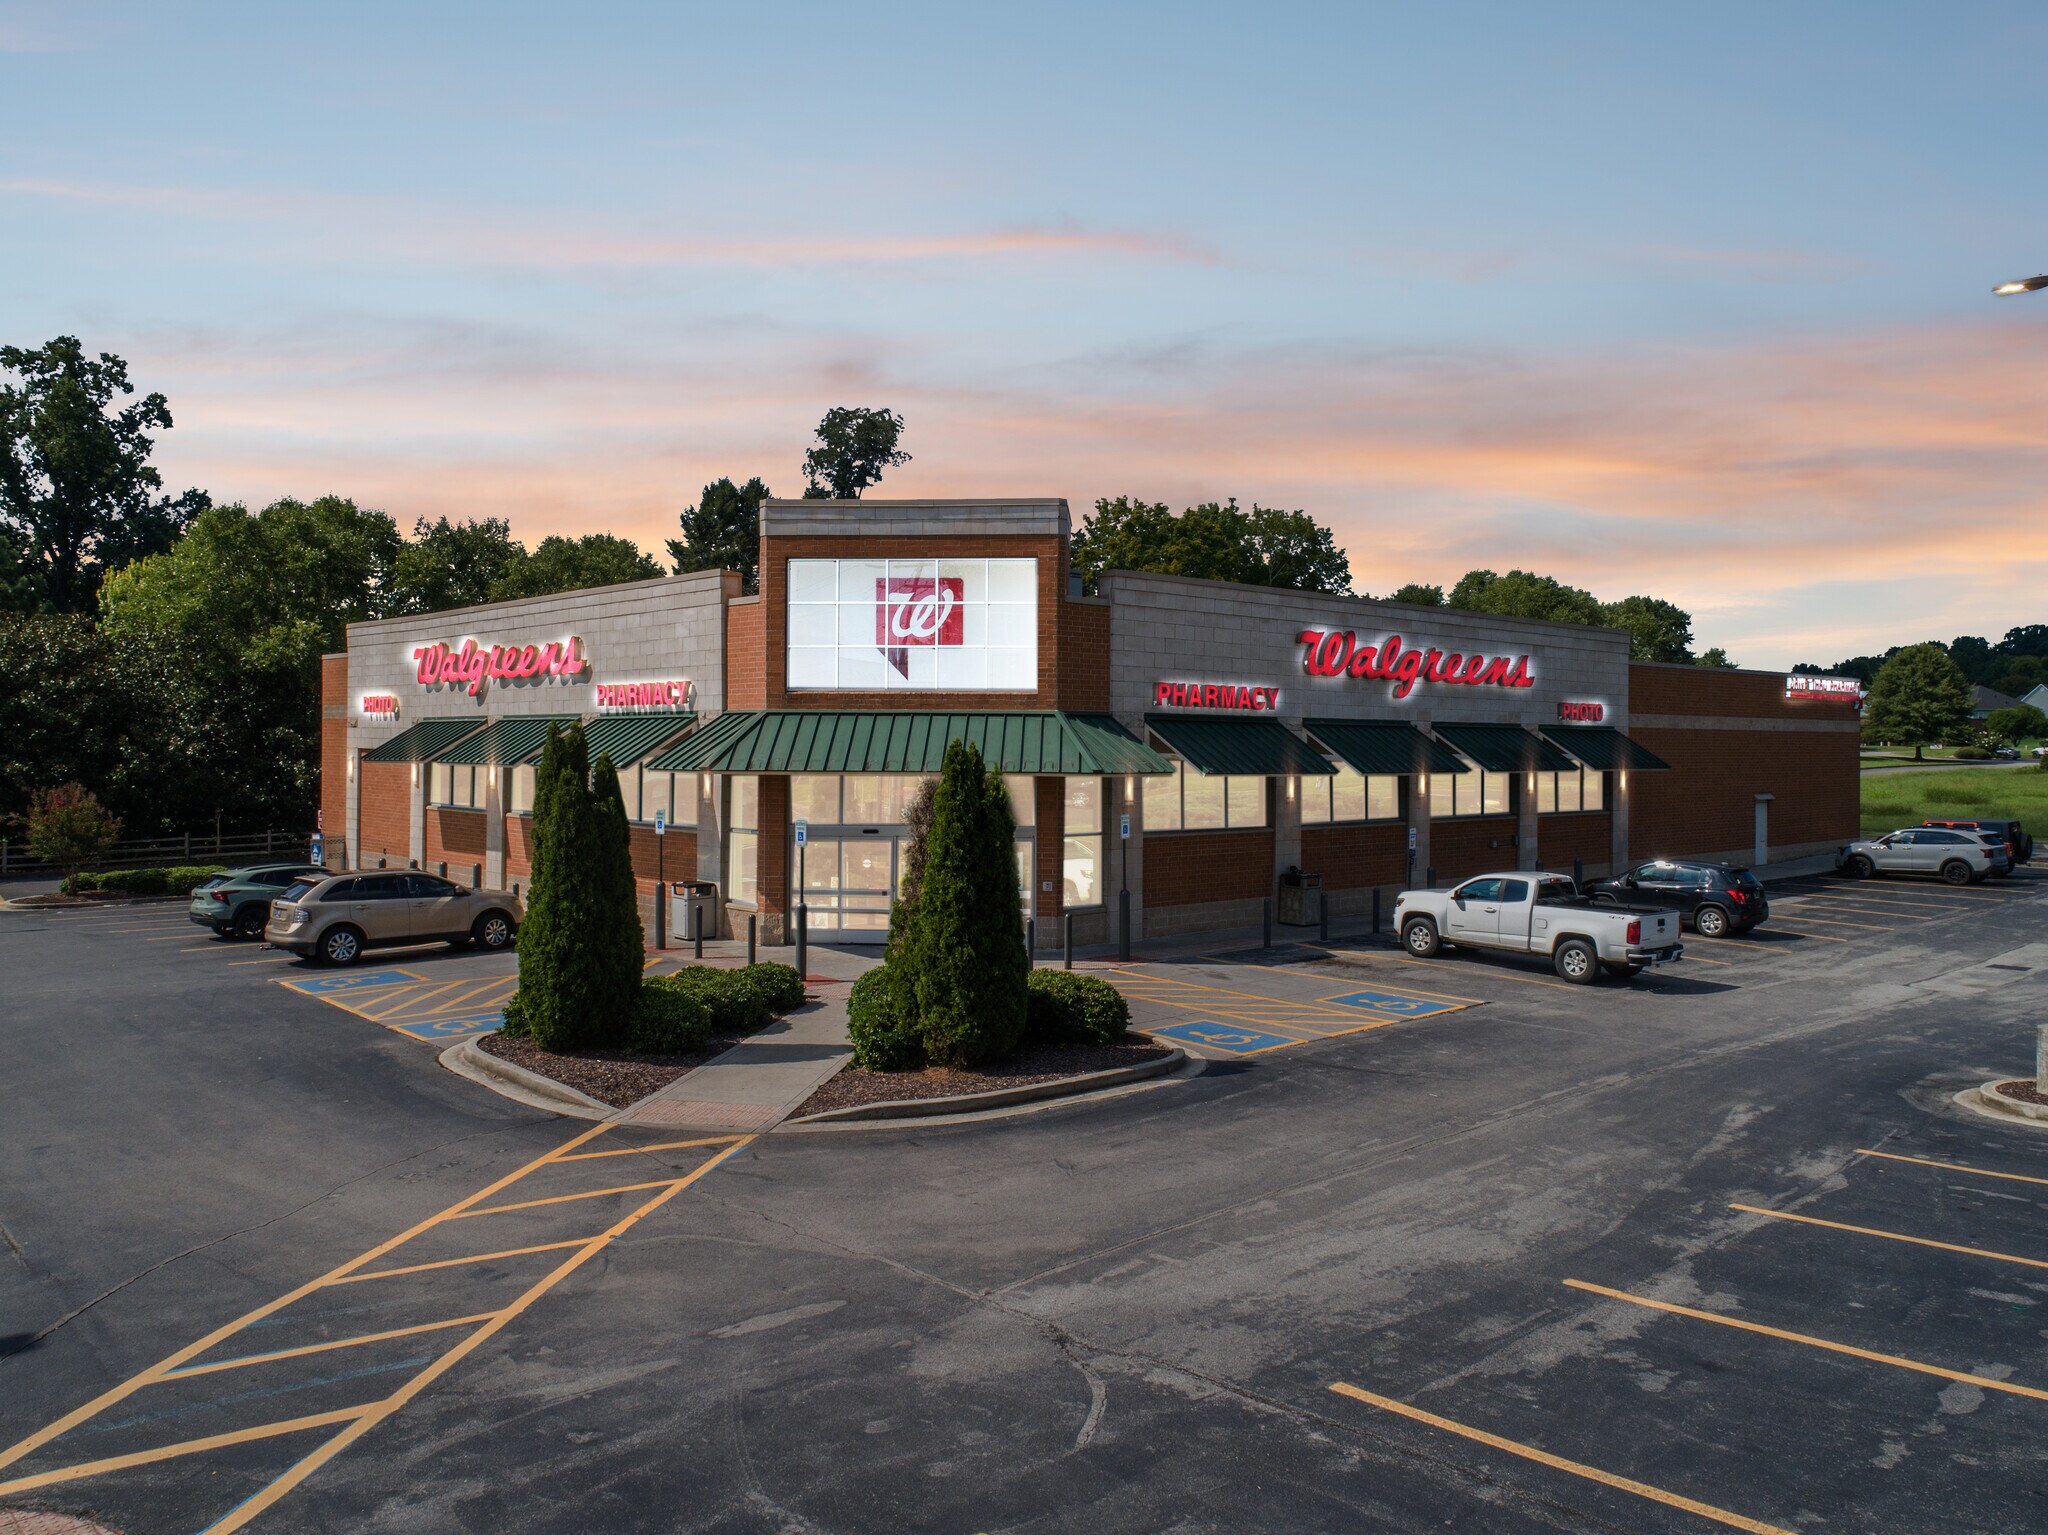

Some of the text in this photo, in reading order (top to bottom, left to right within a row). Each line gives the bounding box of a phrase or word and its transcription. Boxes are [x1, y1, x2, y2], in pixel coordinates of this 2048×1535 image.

[413, 635, 584, 697] Walgreens
[1299, 629, 1535, 699] Walgreens
[363, 696, 393, 712] PHOTO
[597, 681, 688, 706] PHARMACY
[1156, 682, 1279, 710] PHARMACY
[1562, 702, 1604, 721] PHOTO
